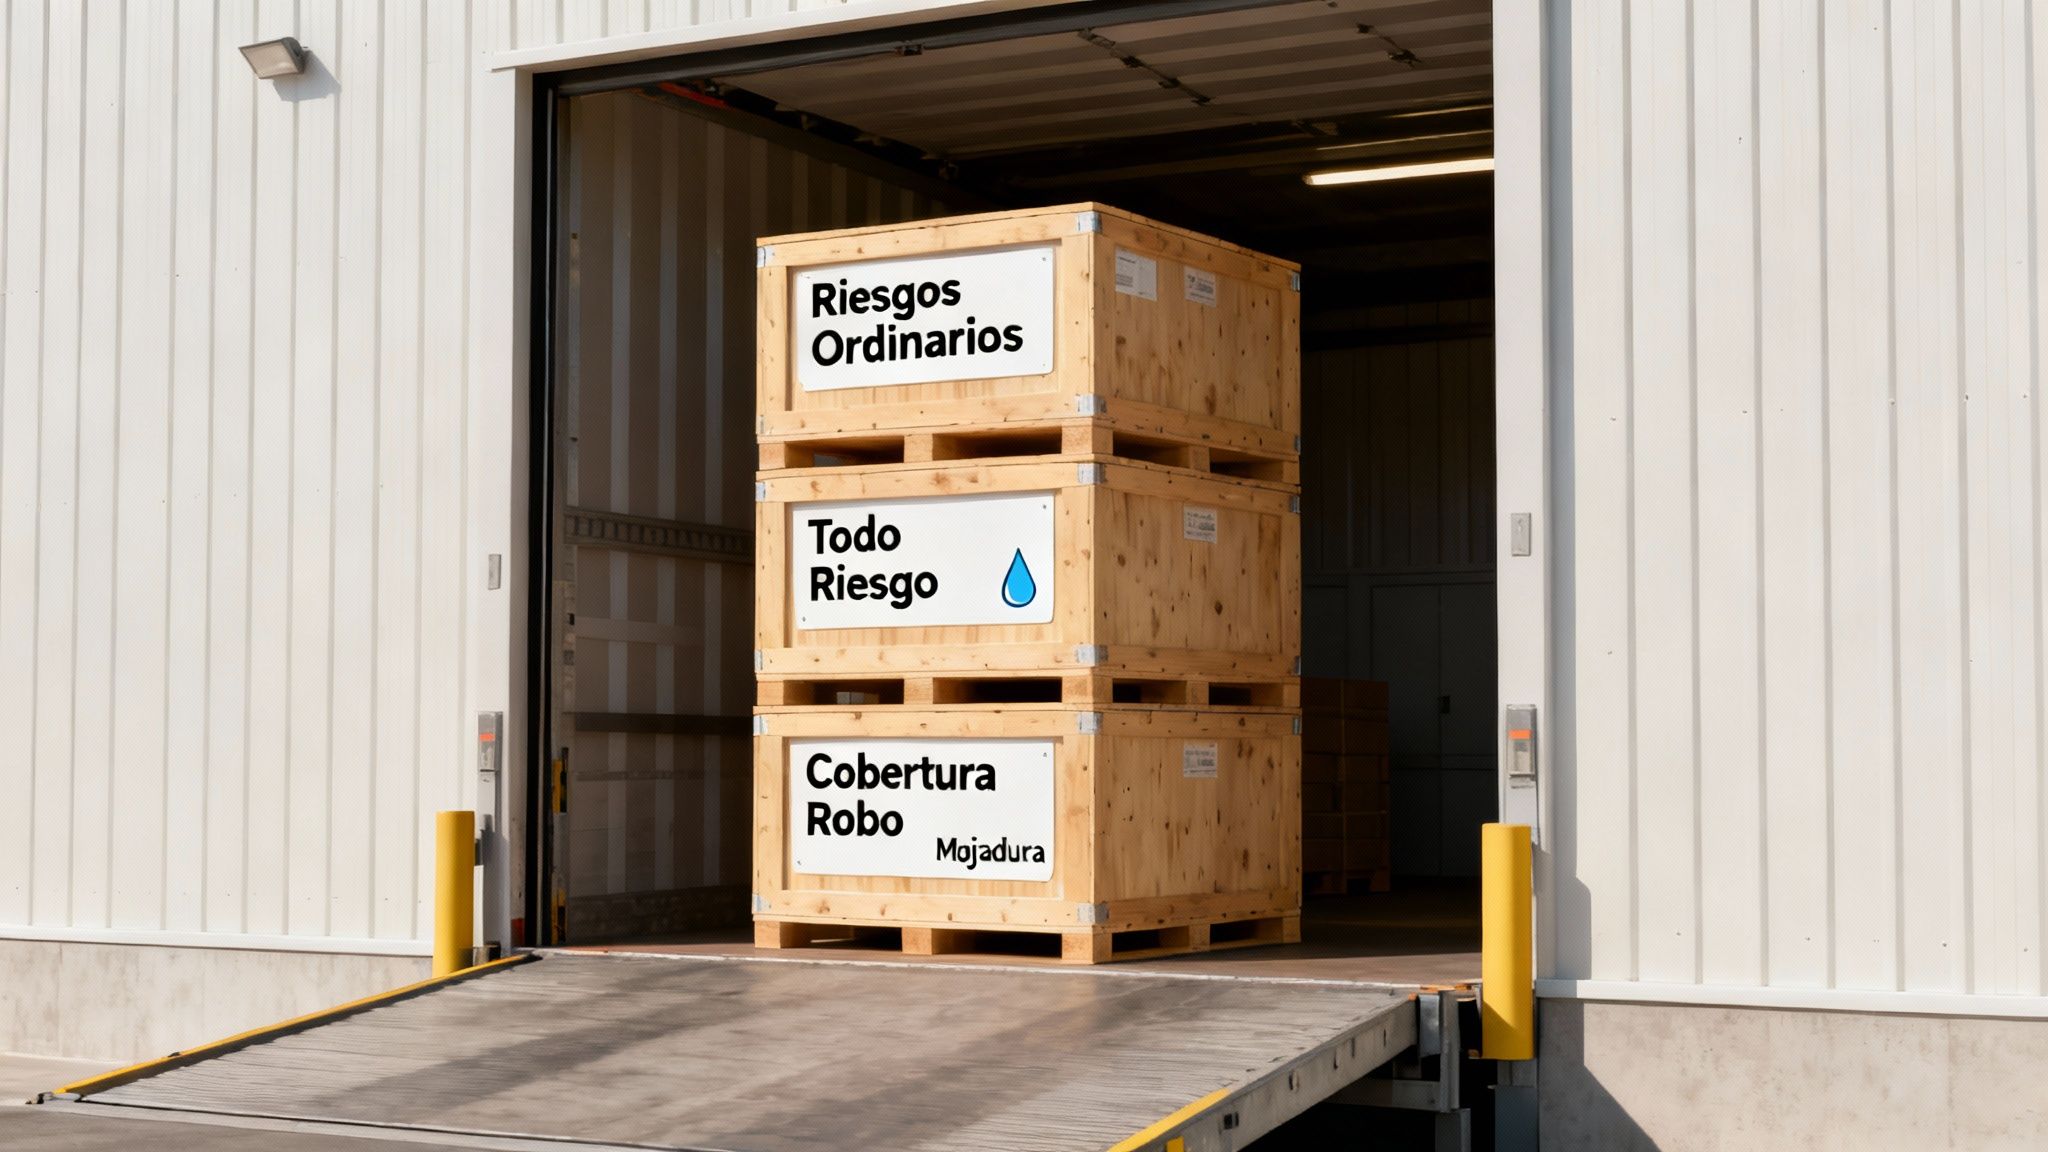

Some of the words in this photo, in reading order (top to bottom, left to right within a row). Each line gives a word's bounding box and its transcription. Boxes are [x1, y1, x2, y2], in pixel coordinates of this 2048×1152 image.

[811, 278, 961, 319] Riesgos
[811, 316, 1024, 367] Ordinarios
[807, 513, 902, 555] Todo
[810, 564, 939, 610] Riesgo
[806, 752, 996, 792] Cobertura
[807, 800, 904, 837] Robo
[936, 836, 1045, 871] Mojadura
